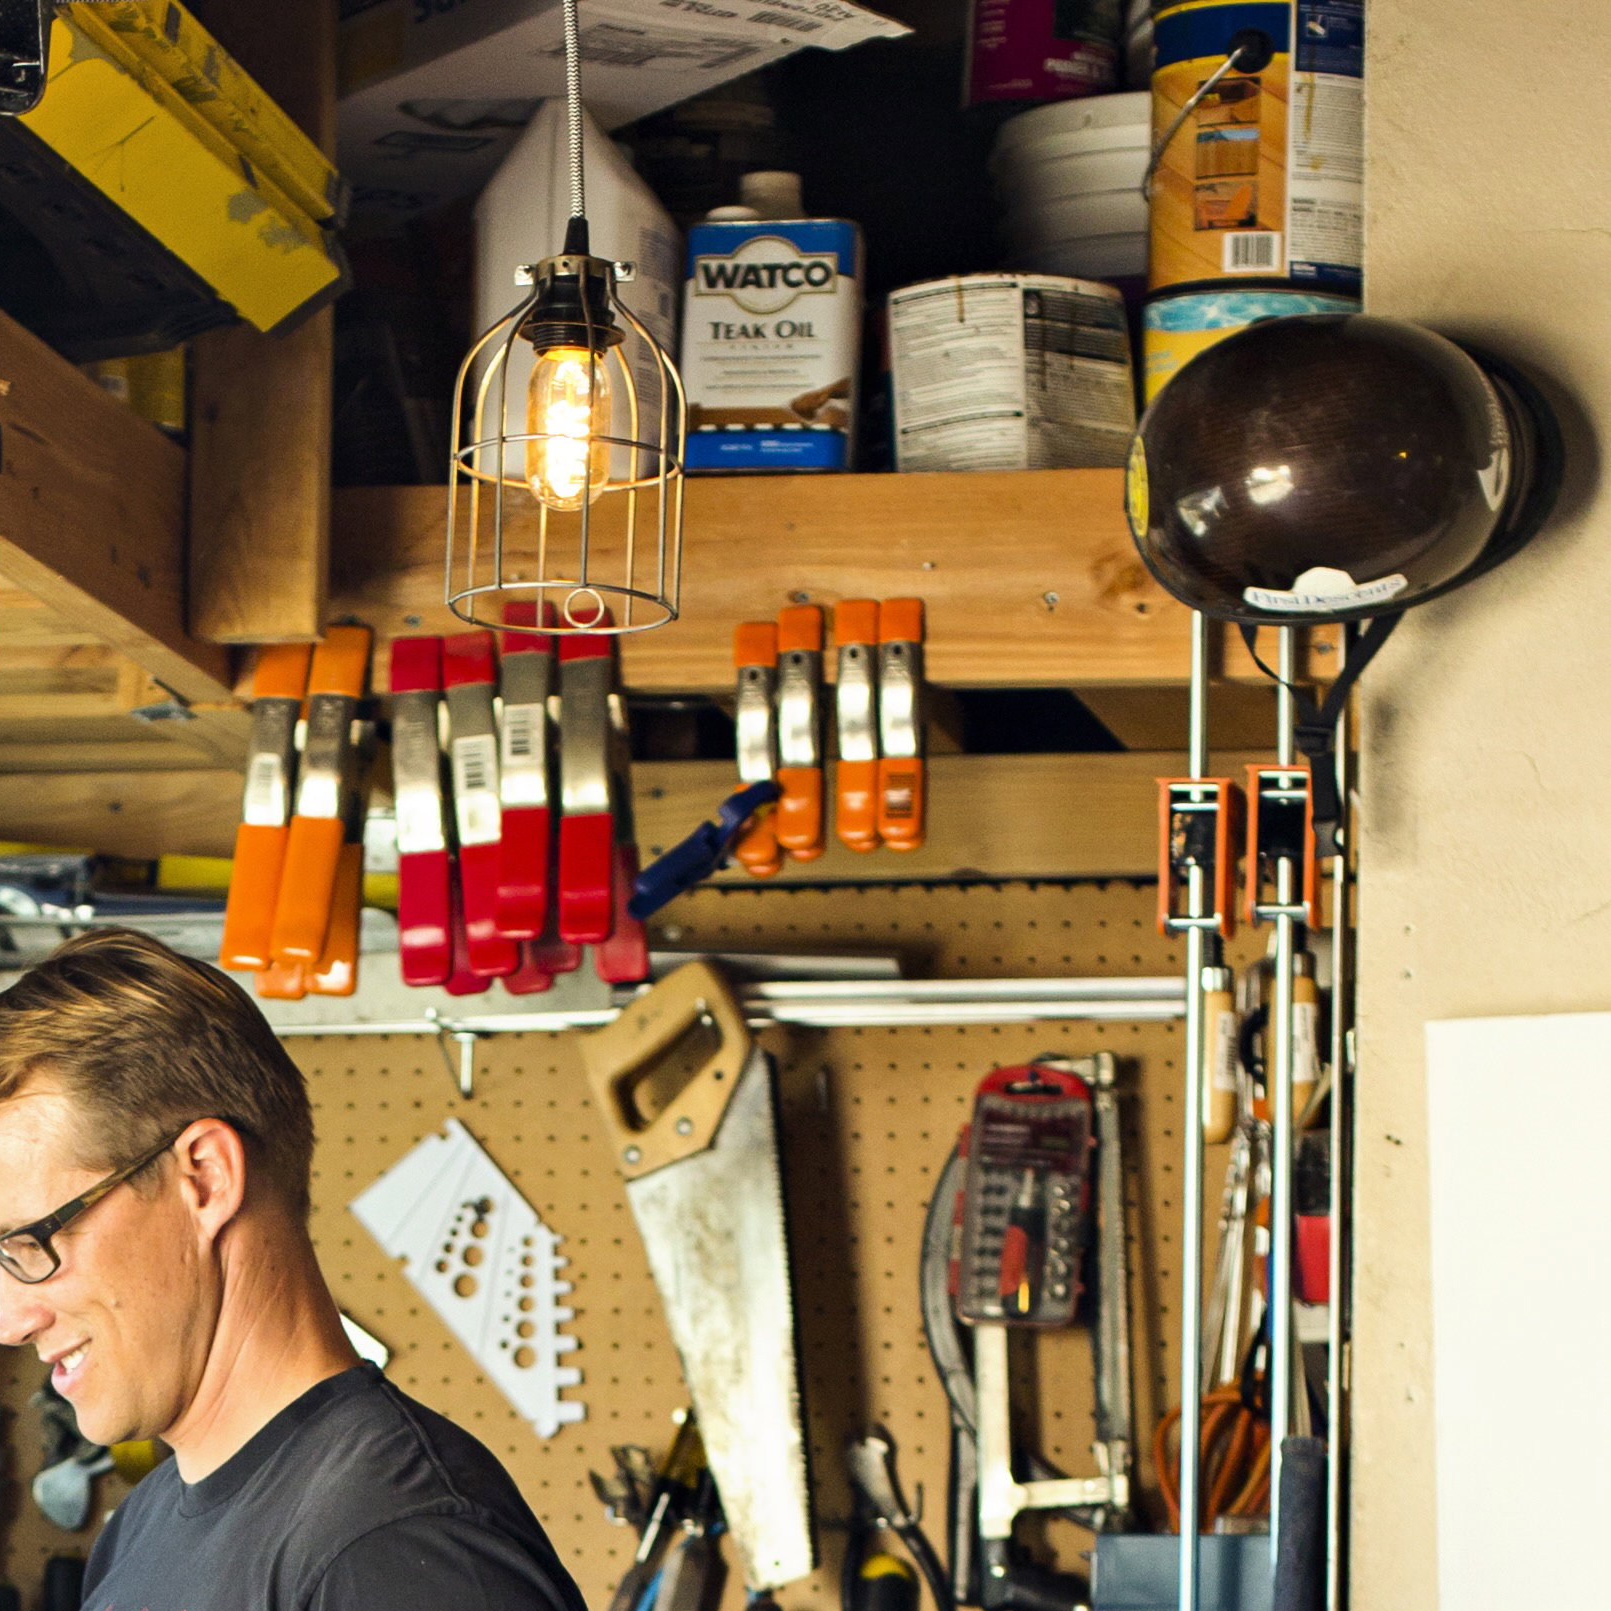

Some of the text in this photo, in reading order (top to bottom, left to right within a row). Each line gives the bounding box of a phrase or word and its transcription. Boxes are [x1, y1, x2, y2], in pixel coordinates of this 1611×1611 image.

[702, 261, 832, 289] WATCO
[710, 320, 815, 340] TEAK OIL
